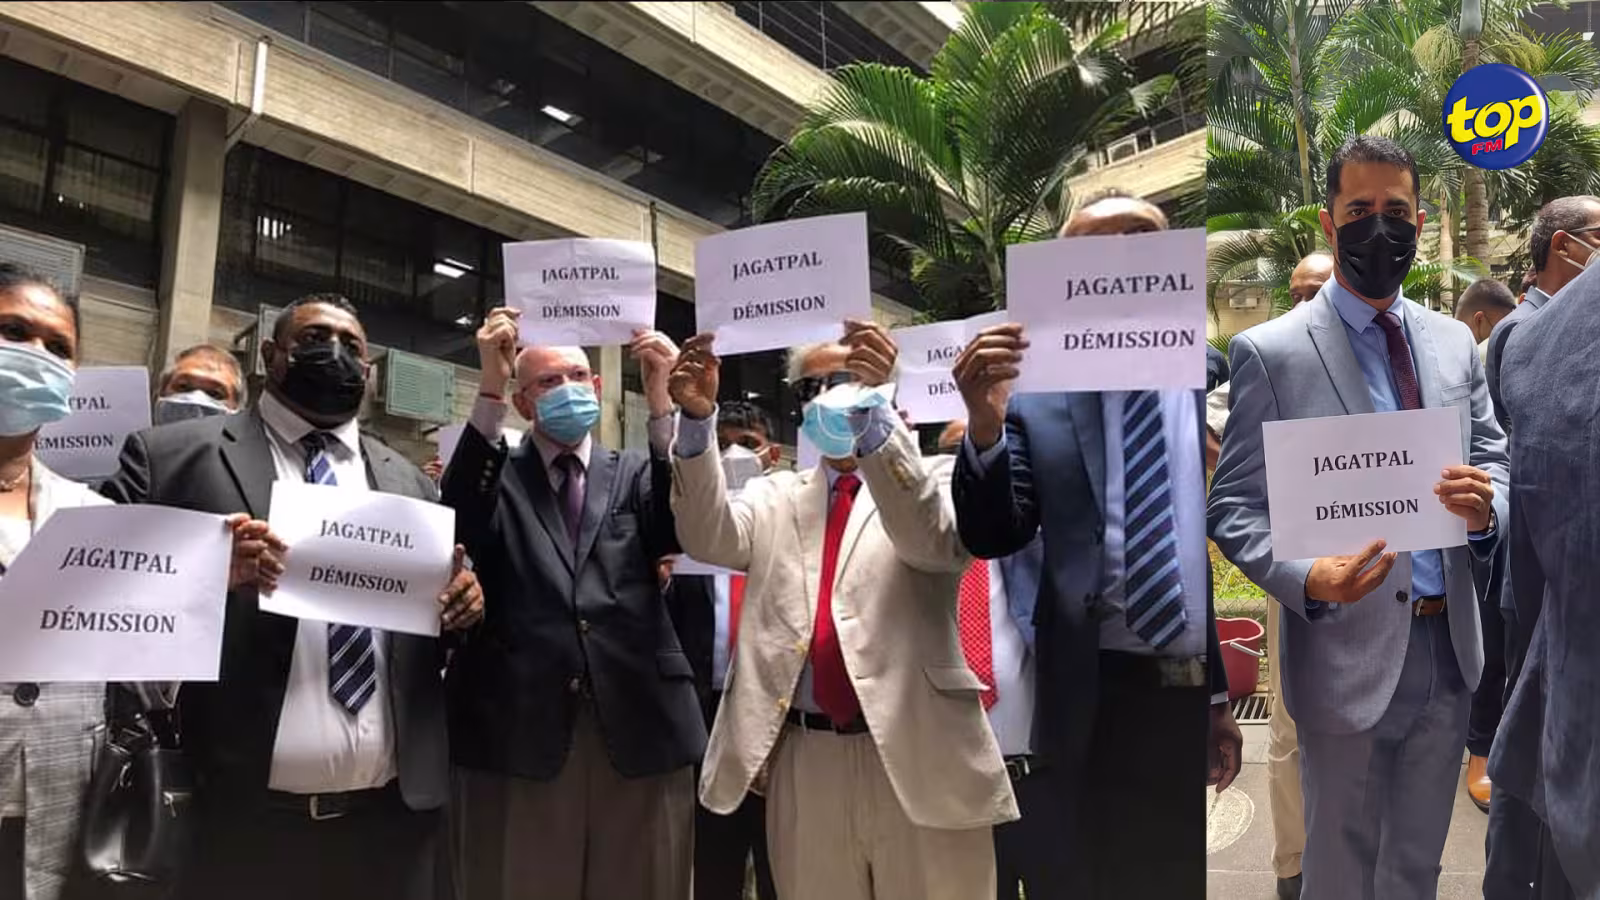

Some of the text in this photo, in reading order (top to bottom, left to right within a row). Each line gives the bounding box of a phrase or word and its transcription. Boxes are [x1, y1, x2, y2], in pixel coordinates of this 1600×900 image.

[541, 265, 620, 284] JAGATPAL
[732, 251, 823, 281] JAGATPAL
[1066, 272, 1194, 301] JAGATPAL
[541, 299, 621, 319] DÉMISSION
[732, 294, 826, 322] DÉMISSION
[1063, 327, 1196, 352] DÉMISSION
[1312, 450, 1415, 476] JAGATPAL
[1315, 497, 1420, 522] DÉMISSION
[319, 519, 415, 550] JAGATPAL
[59, 546, 178, 575] JAGATPAL
[309, 564, 408, 595] DÉMISSION
[39, 605, 176, 635] DÉMISSION
